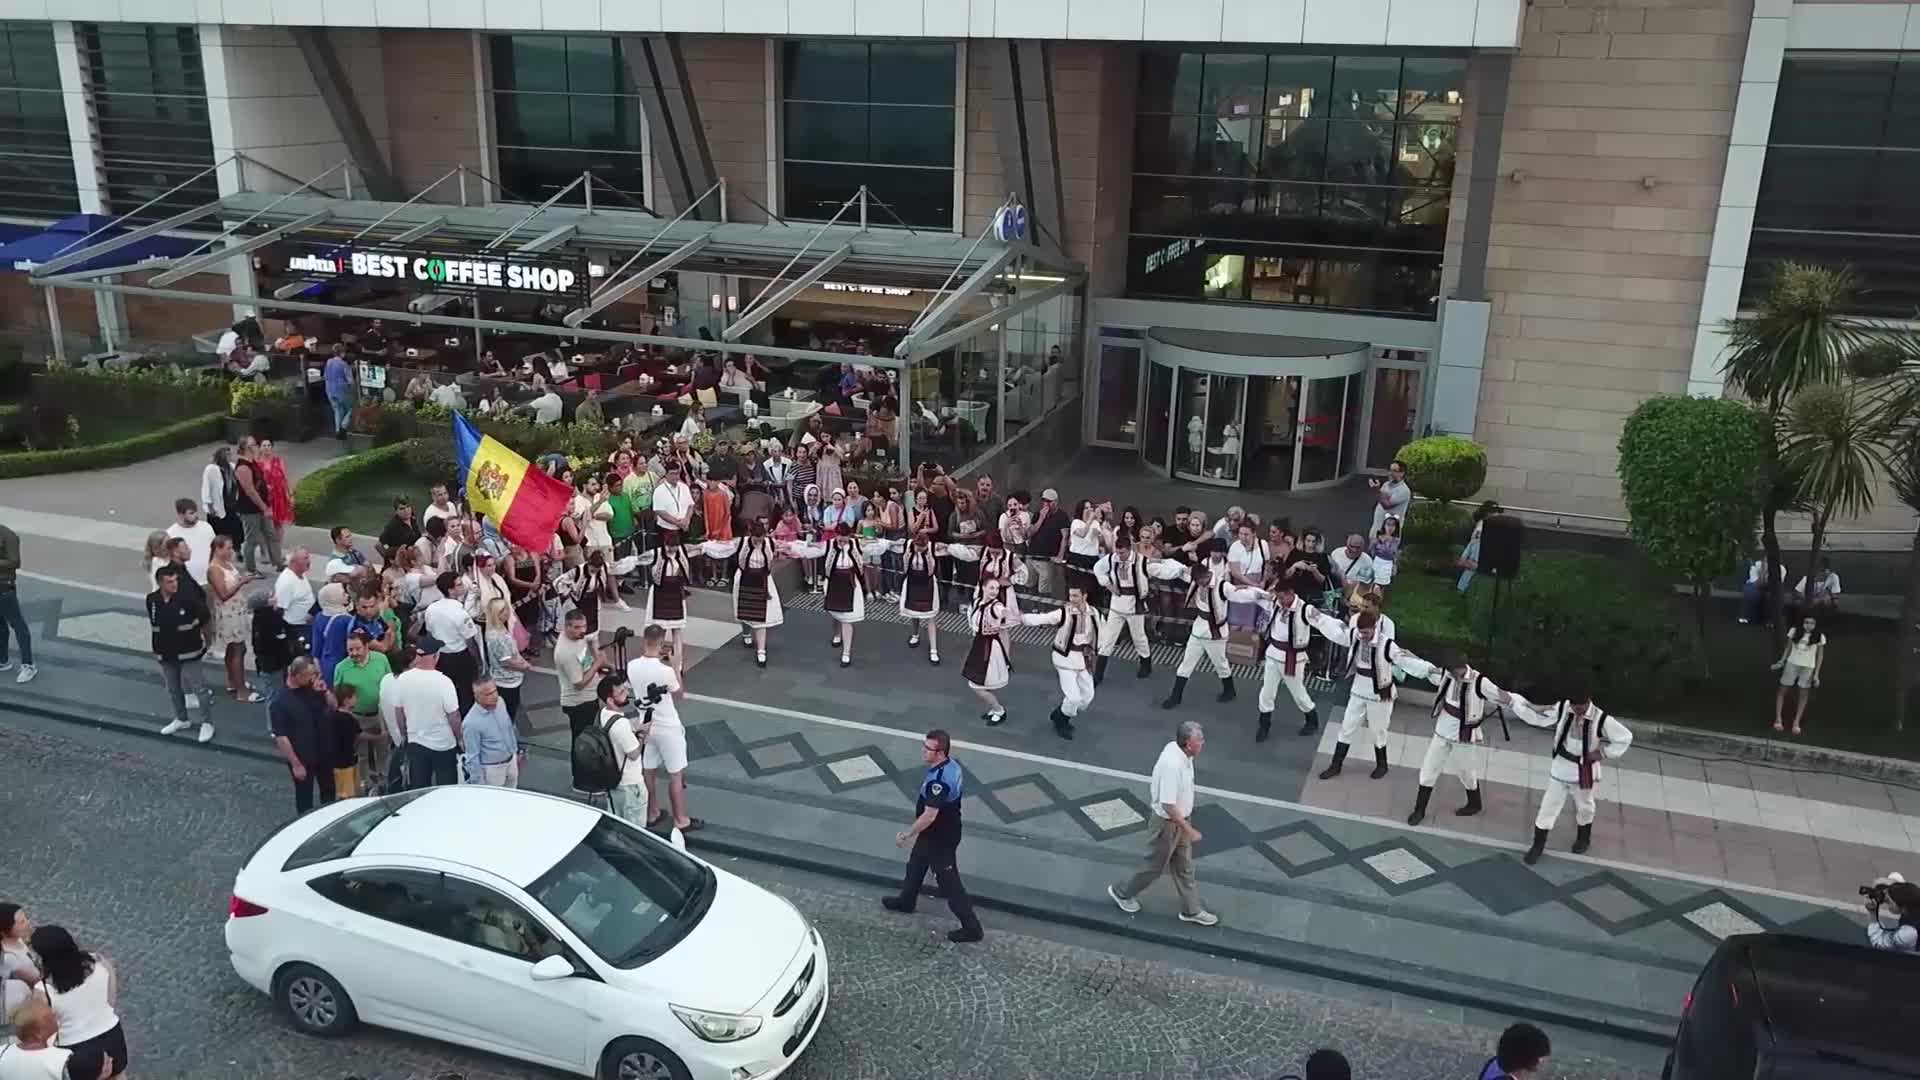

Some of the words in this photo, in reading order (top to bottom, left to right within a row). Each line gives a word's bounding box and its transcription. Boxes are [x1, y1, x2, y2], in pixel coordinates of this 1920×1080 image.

[352, 253, 408, 278] BEST
[413, 257, 502, 286] COFFEE
[507, 265, 574, 292] SHOP
[848, 284, 883, 294] CFFEE
